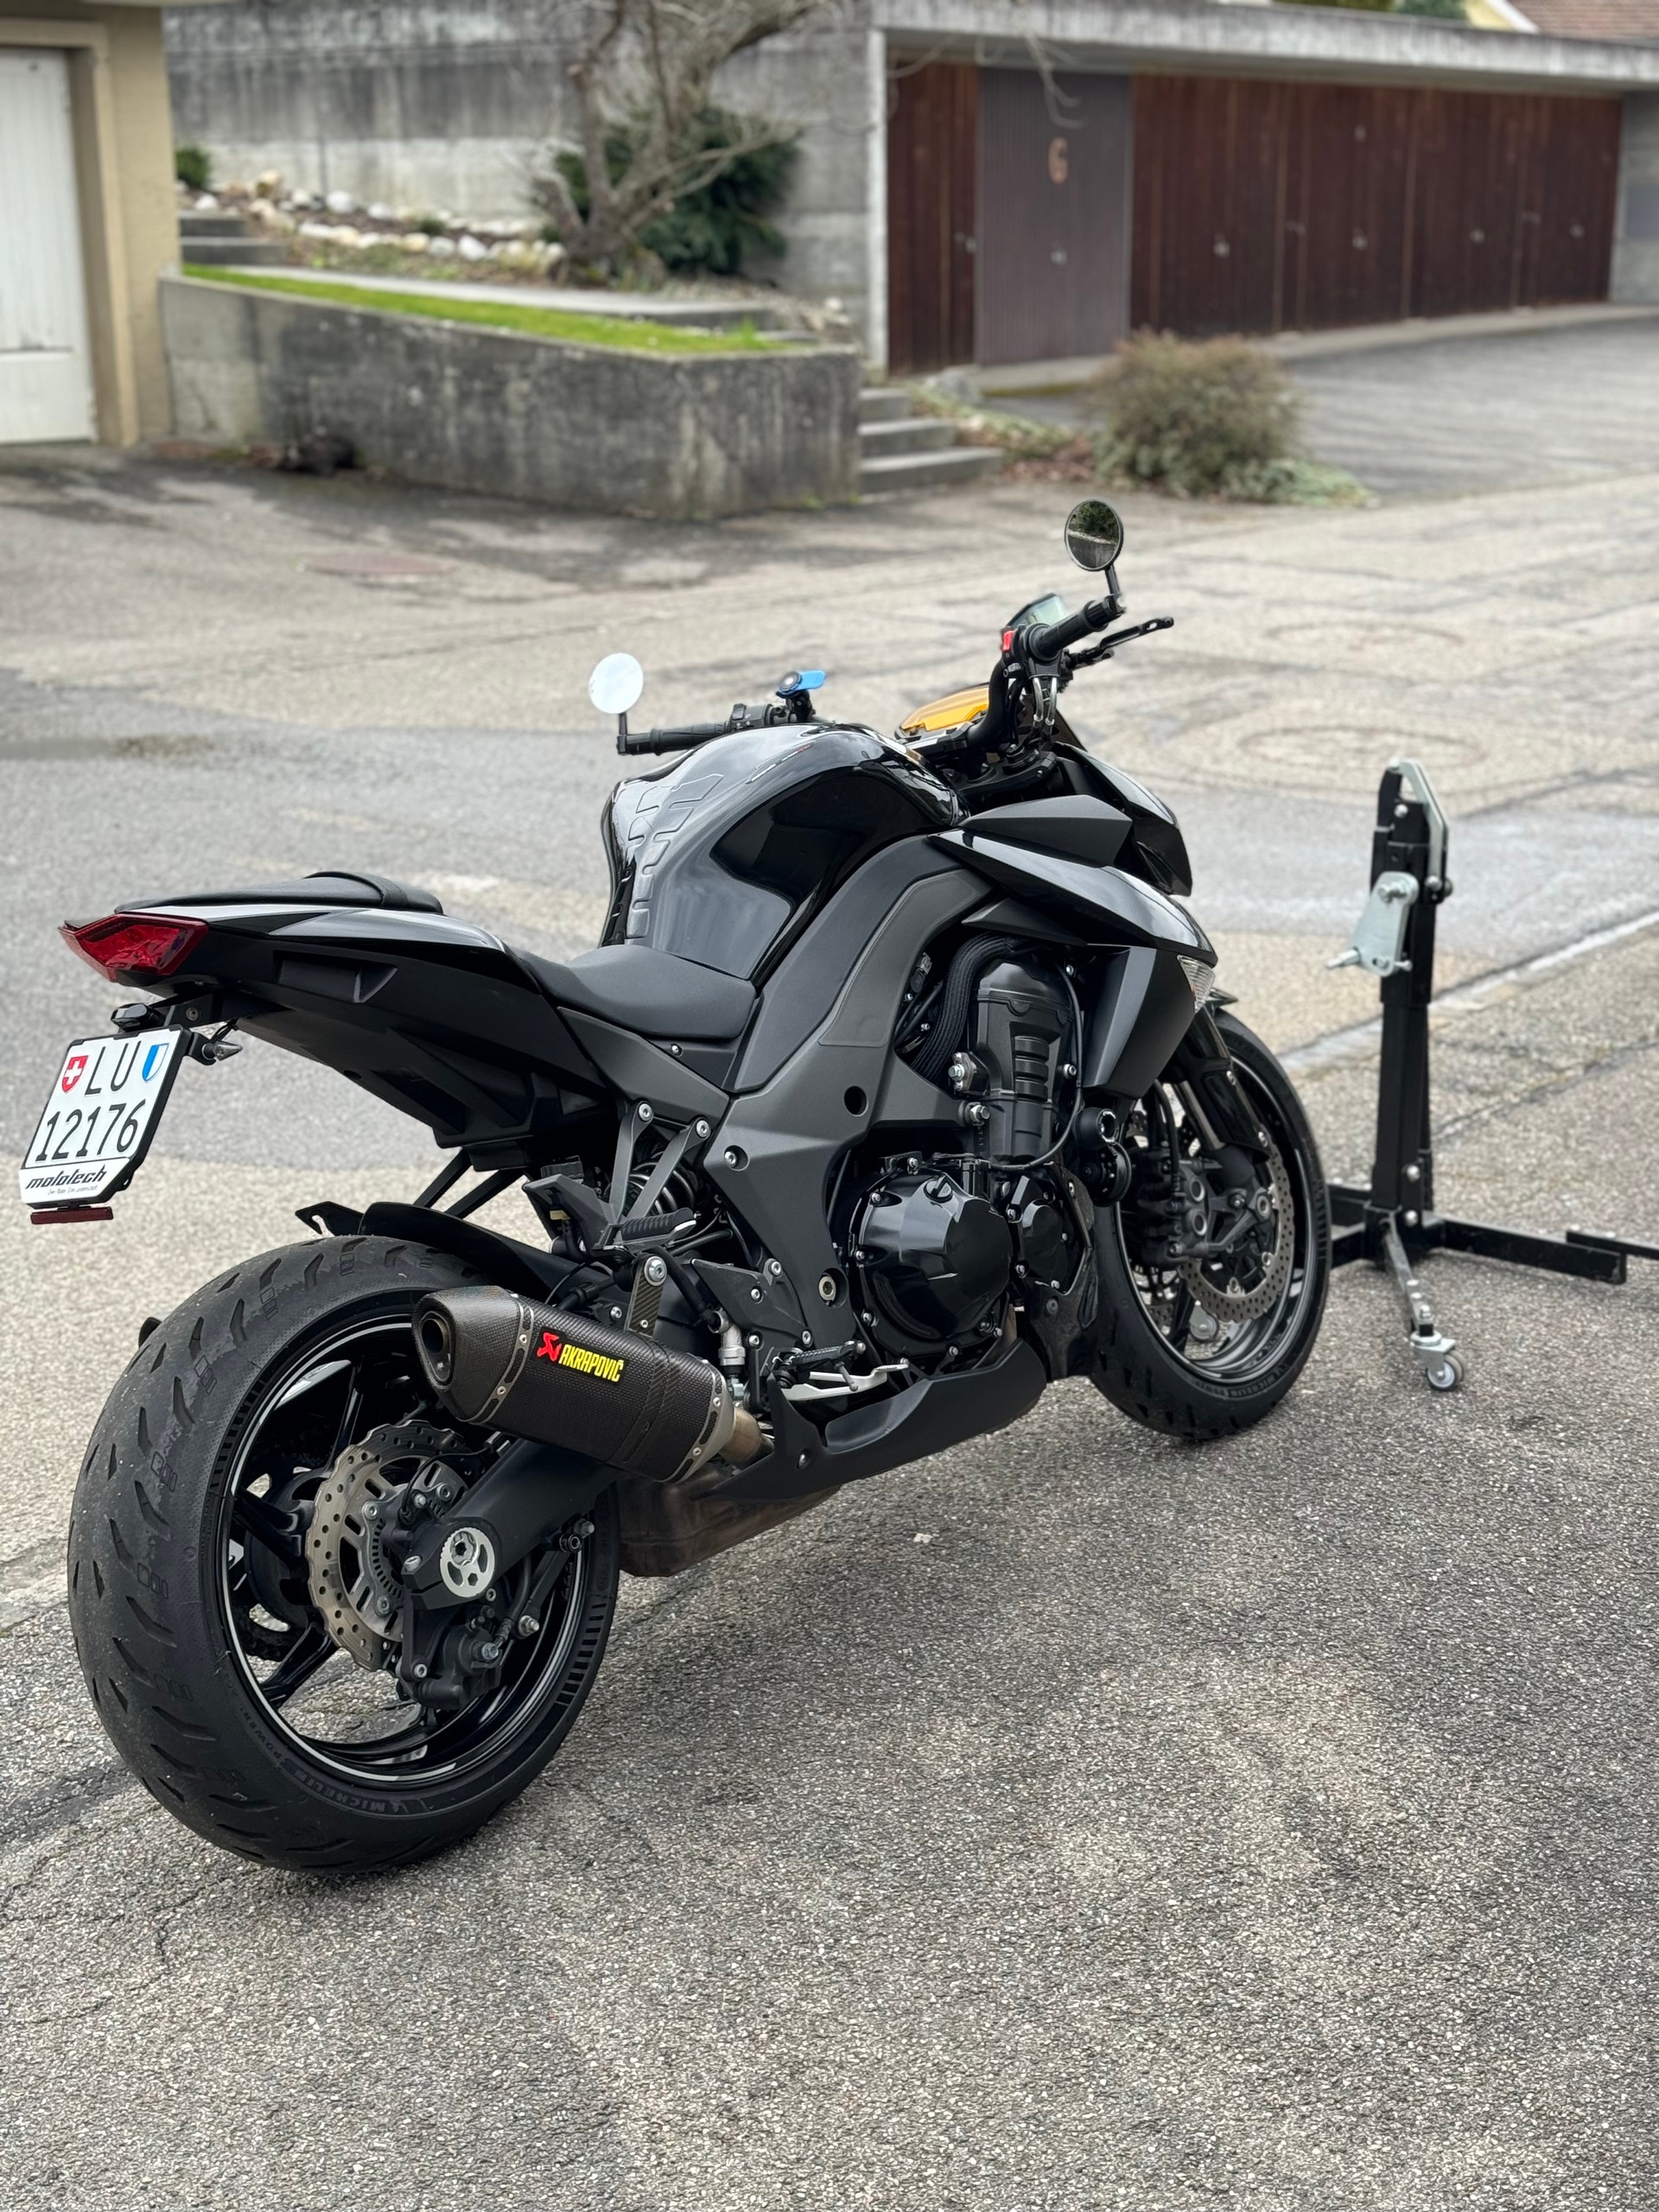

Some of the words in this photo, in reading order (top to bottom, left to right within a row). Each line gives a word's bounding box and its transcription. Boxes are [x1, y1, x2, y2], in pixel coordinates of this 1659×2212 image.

[85, 1040, 142, 1096] LU
[35, 1099, 146, 1162] 12176
[1230, 1375, 1276, 1397] MICHELIN
[243, 1710, 282, 1759] POWER
[293, 1770, 386, 1813] MICHELIN
